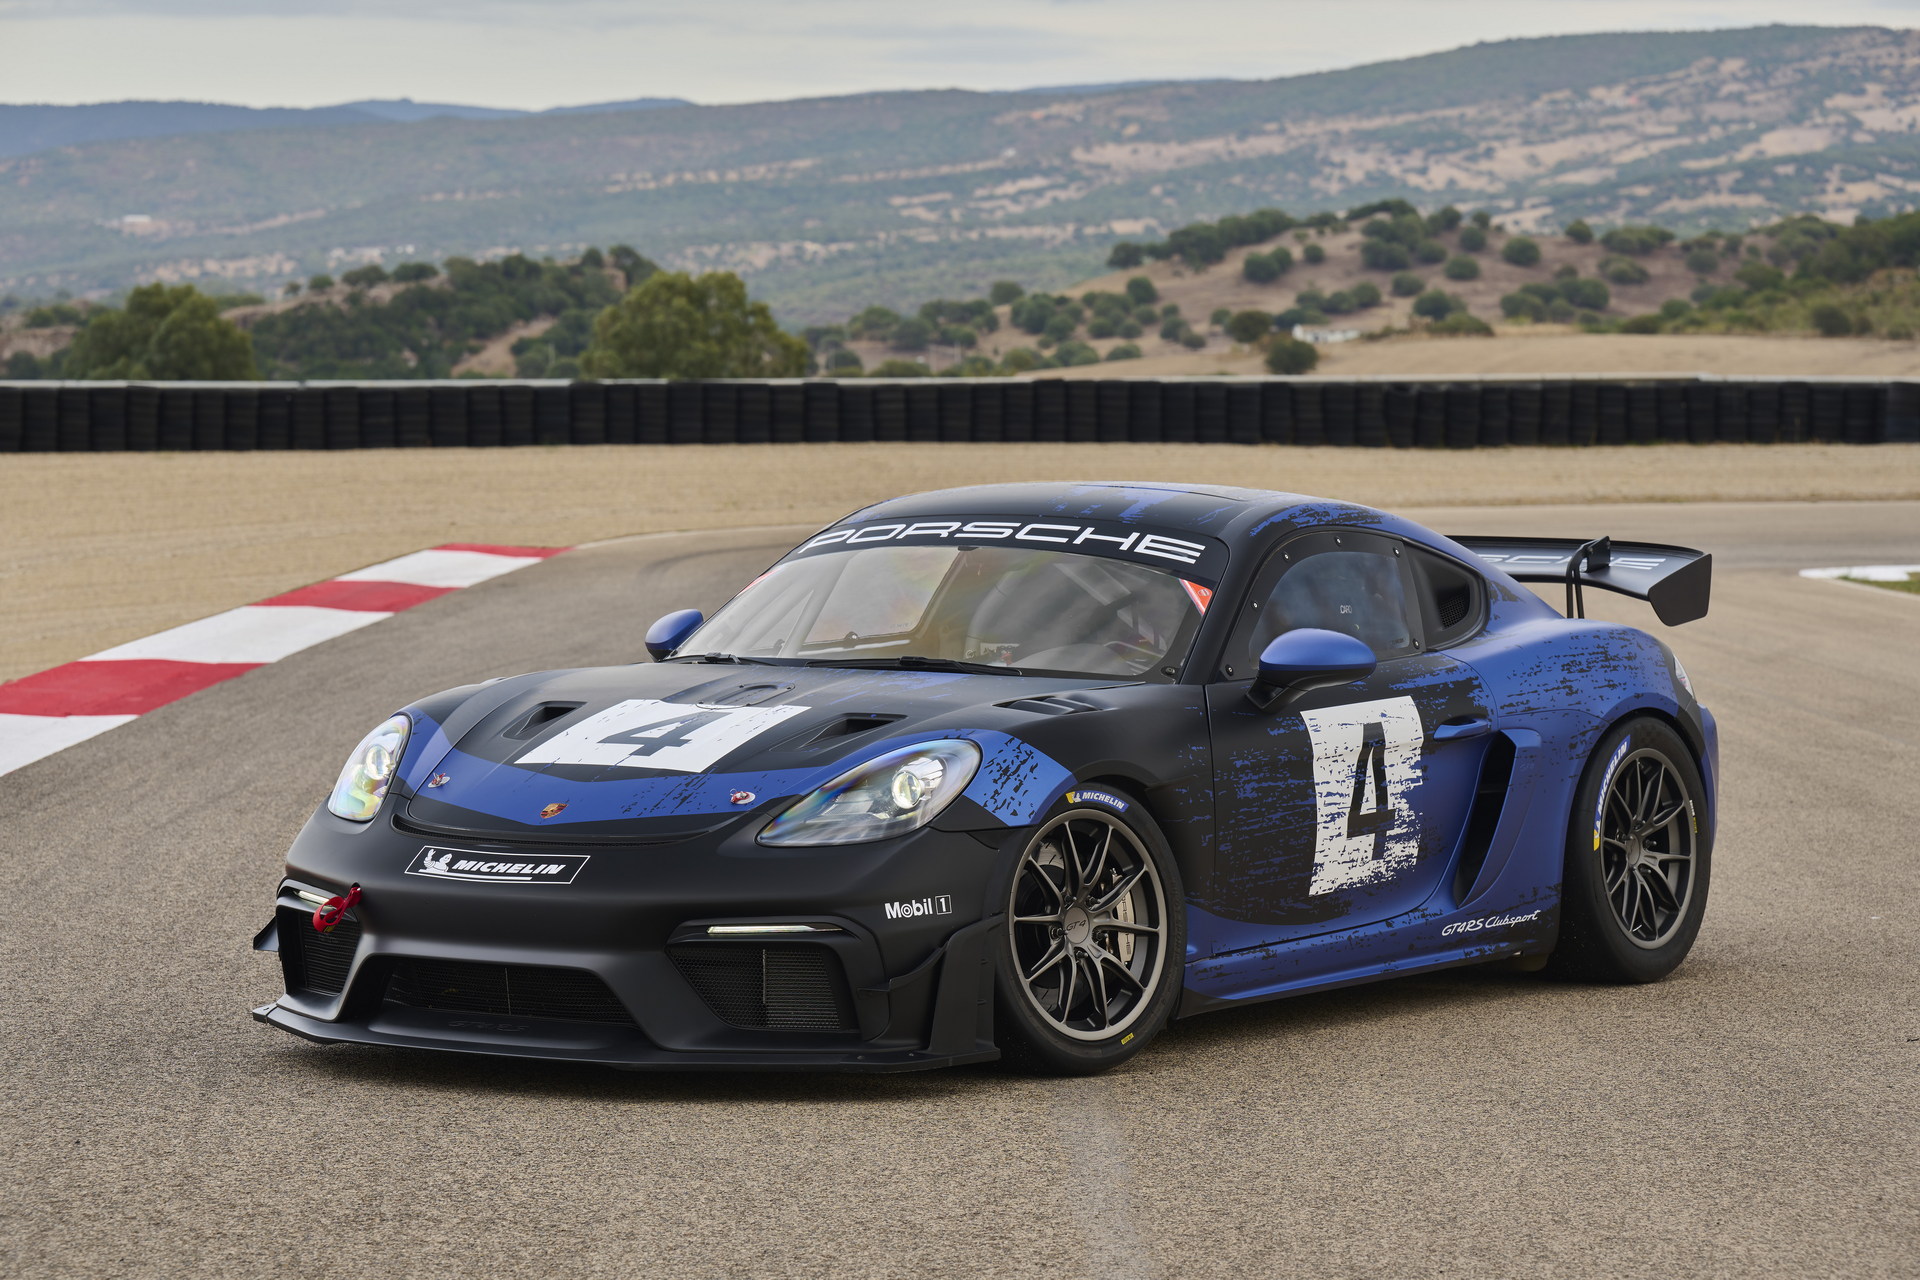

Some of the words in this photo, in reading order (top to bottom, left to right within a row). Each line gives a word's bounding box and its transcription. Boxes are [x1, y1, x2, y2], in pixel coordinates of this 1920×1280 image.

[798, 521, 1206, 564] PORSCHE
[596, 710, 734, 757] 4
[1346, 721, 1396, 861] 4
[1598, 741, 1628, 816] MICHELIN
[1082, 791, 1125, 810] MICHELIN
[451, 859, 566, 875] MICHELIN
[884, 897, 933, 919] Mobil
[1485, 909, 1541, 928] Clubsport
